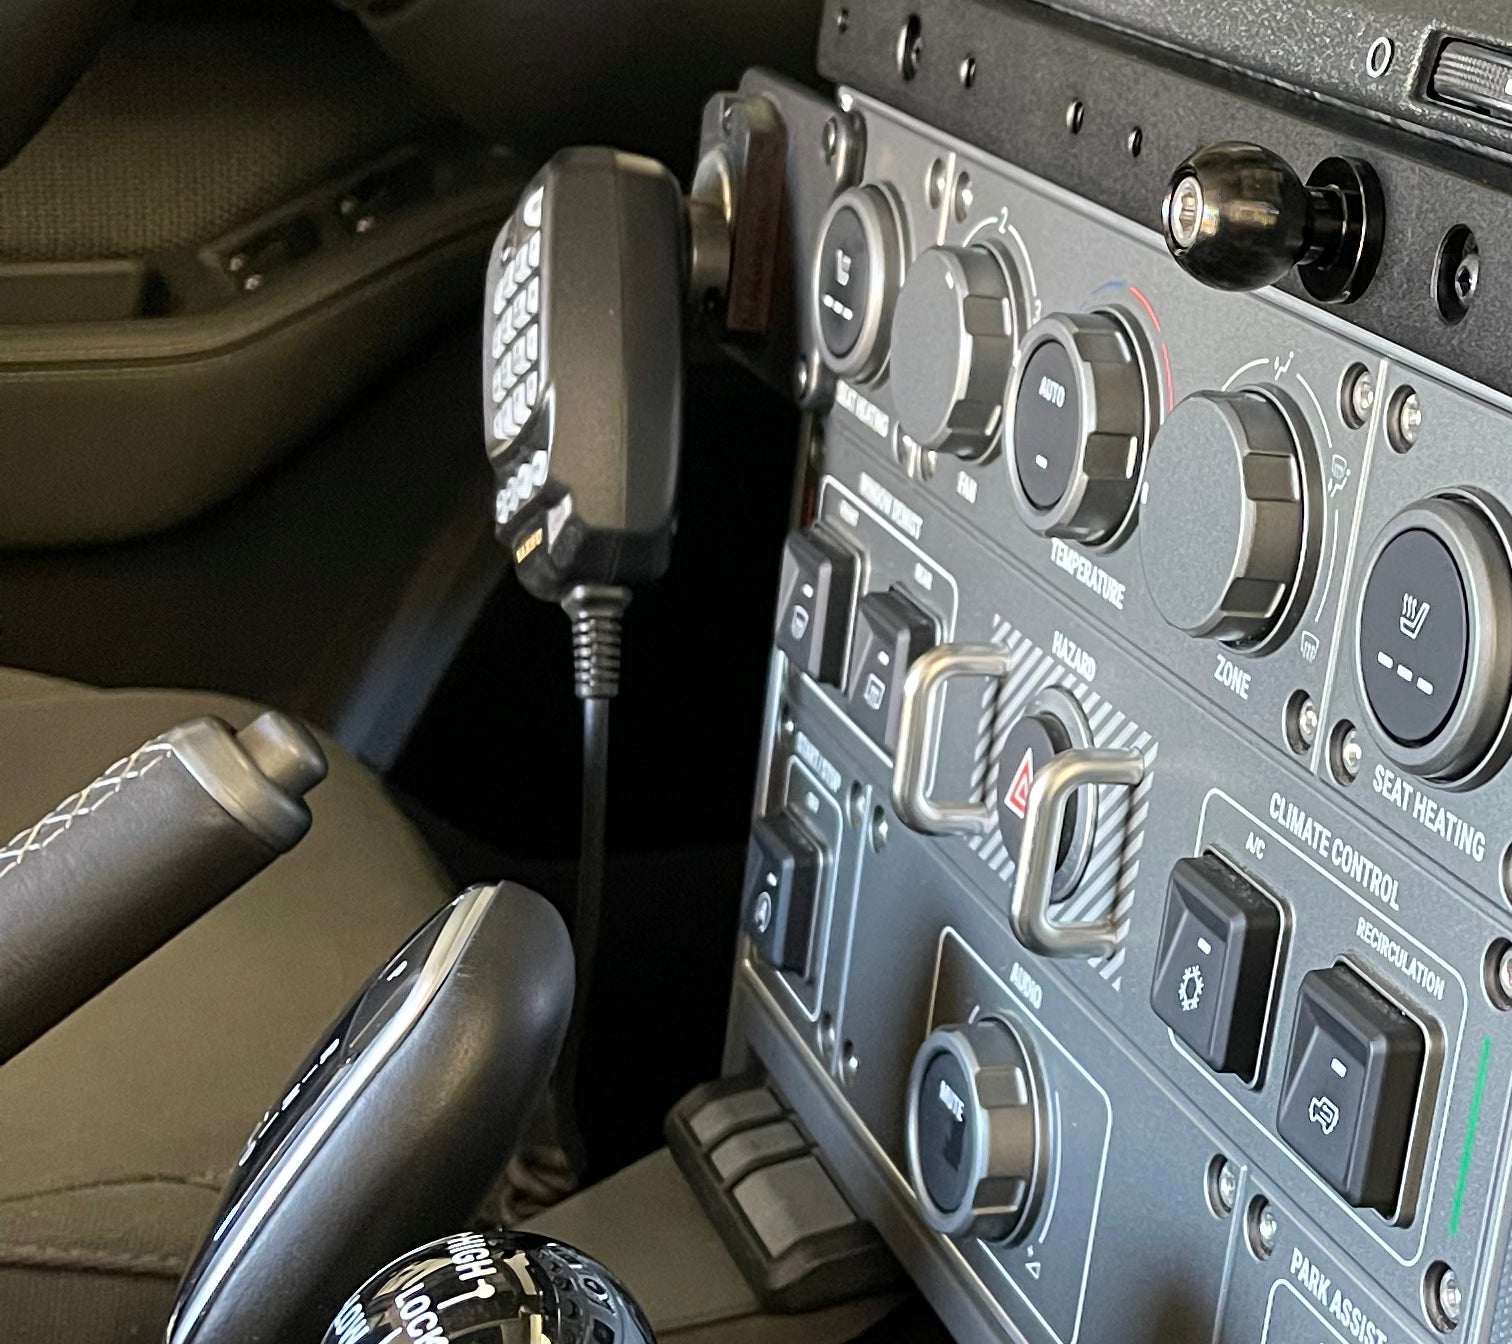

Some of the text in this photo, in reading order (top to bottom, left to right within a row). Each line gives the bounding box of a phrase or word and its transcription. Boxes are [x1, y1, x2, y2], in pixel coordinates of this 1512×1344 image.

[1038, 375, 1066, 408] AUTO
[956, 470, 978, 505] FAN
[1050, 538, 1125, 610] TEMPERATURE
[1051, 630, 1097, 683] HAZARD
[1214, 653, 1252, 702] ZONE
[1372, 763, 1486, 863] SEAT HEATING
[1245, 830, 1266, 861] A/C
[1269, 791, 1400, 912] CLIMATE CONTROL
[1356, 915, 1446, 1001] RECIRCULATION
[1009, 961, 1043, 1010] AUDIO
[939, 1079, 965, 1123] MUTE
[447, 1231, 498, 1282] HIGH
[1290, 1247, 1330, 1305] PARK
